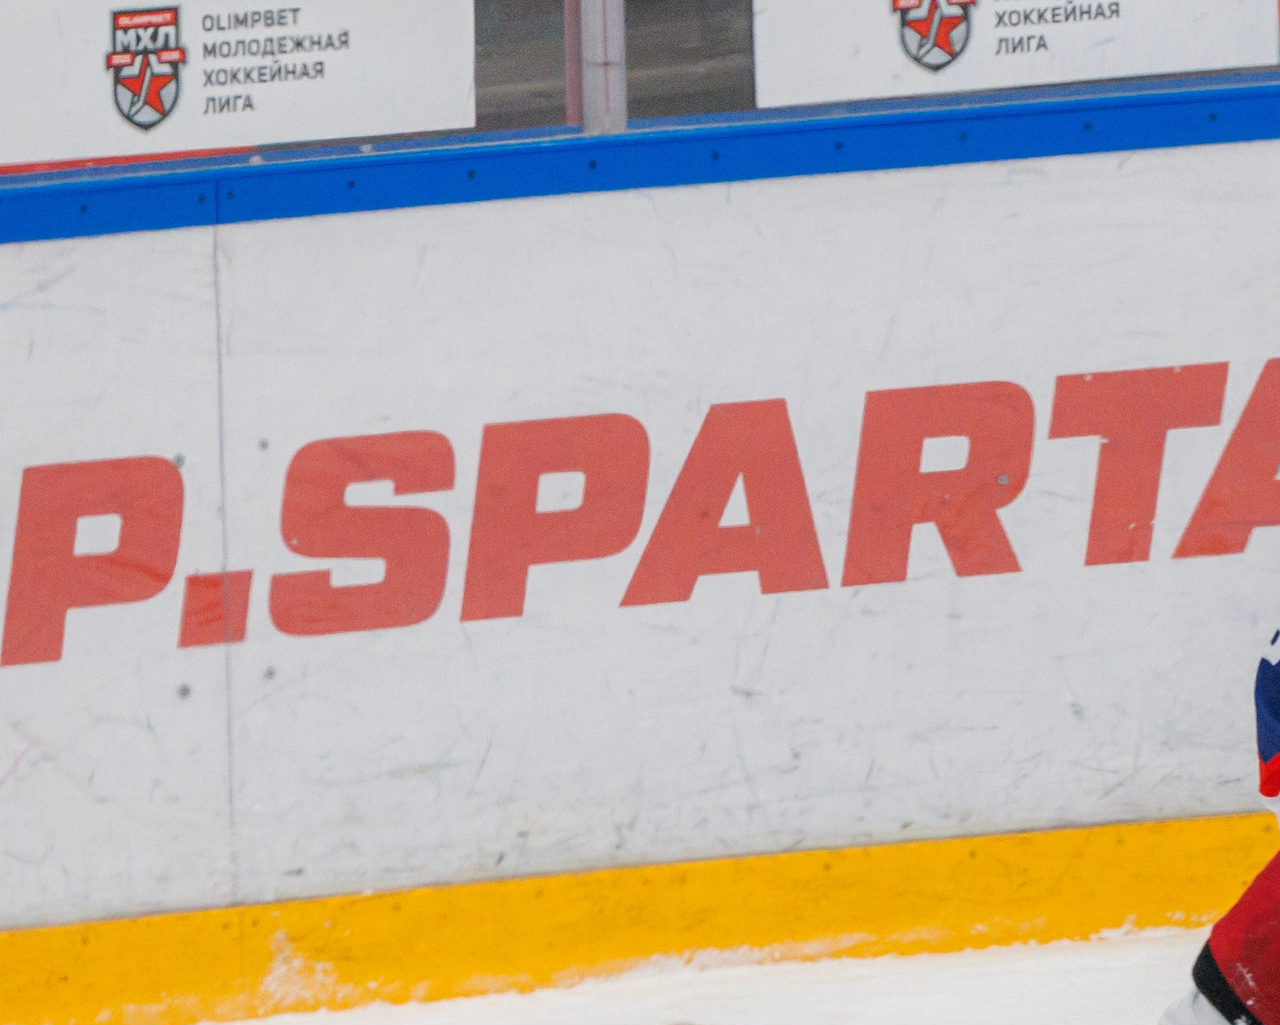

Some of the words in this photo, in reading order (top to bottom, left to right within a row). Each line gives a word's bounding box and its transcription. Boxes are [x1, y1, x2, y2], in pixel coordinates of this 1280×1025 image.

[202, 8, 300, 31] OLIMPBET
[994, 2, 1120, 28] ХОККЕЙНАЯ
[115, 26, 176, 51] МХЛ
[203, 30, 350, 58] МОЛОДЕЖНАЯ
[995, 34, 1048, 55] ЛИГА
[203, 60, 325, 87] ХОККЕЙНАЯ
[203, 94, 255, 114] ЛИГА
